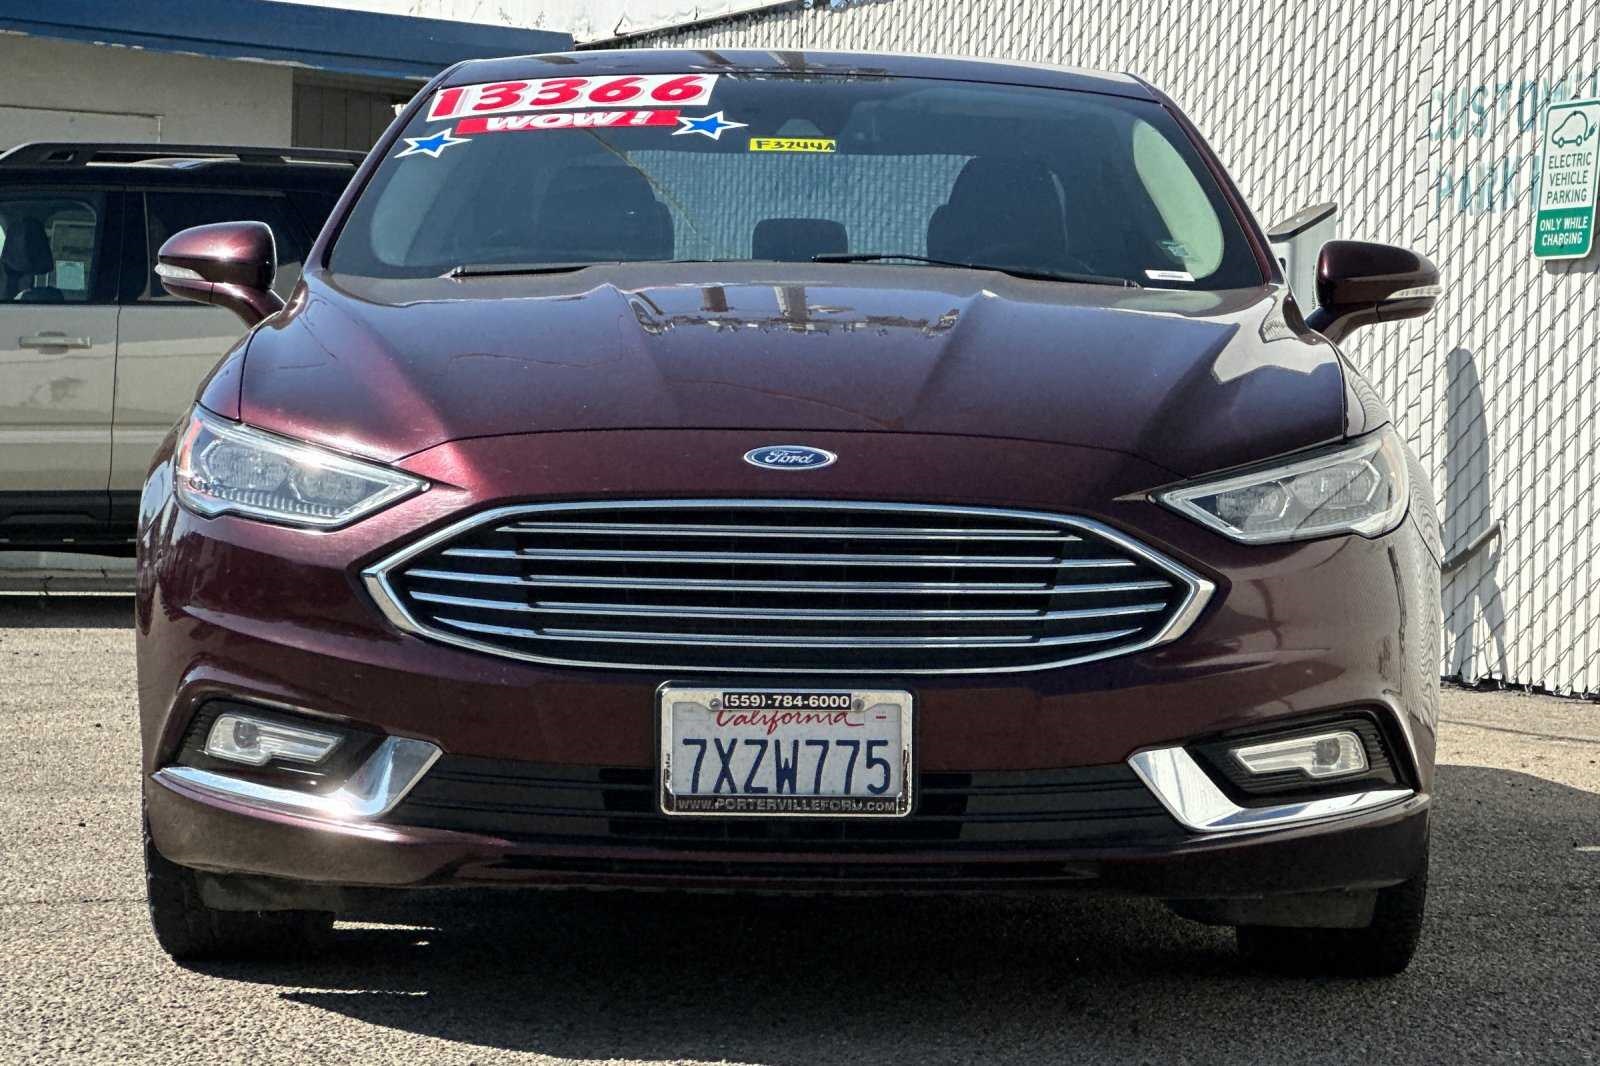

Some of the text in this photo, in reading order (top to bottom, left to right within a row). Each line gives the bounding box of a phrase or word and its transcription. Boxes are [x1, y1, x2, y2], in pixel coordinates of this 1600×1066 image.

[432, 75, 708, 117] 13366
[486, 111, 654, 132] WOW!
[1548, 152, 1592, 170] ELECTRIC
[1549, 170, 1589, 187] VEHICLE
[1546, 188, 1587, 205] PARKING
[1540, 215, 1589, 232] ONLY WHILE
[1542, 232, 1583, 247] CHARGING
[764, 448, 816, 464] Ford
[716, 708, 865, 735] California
[682, 738, 892, 795] 7XZW775
